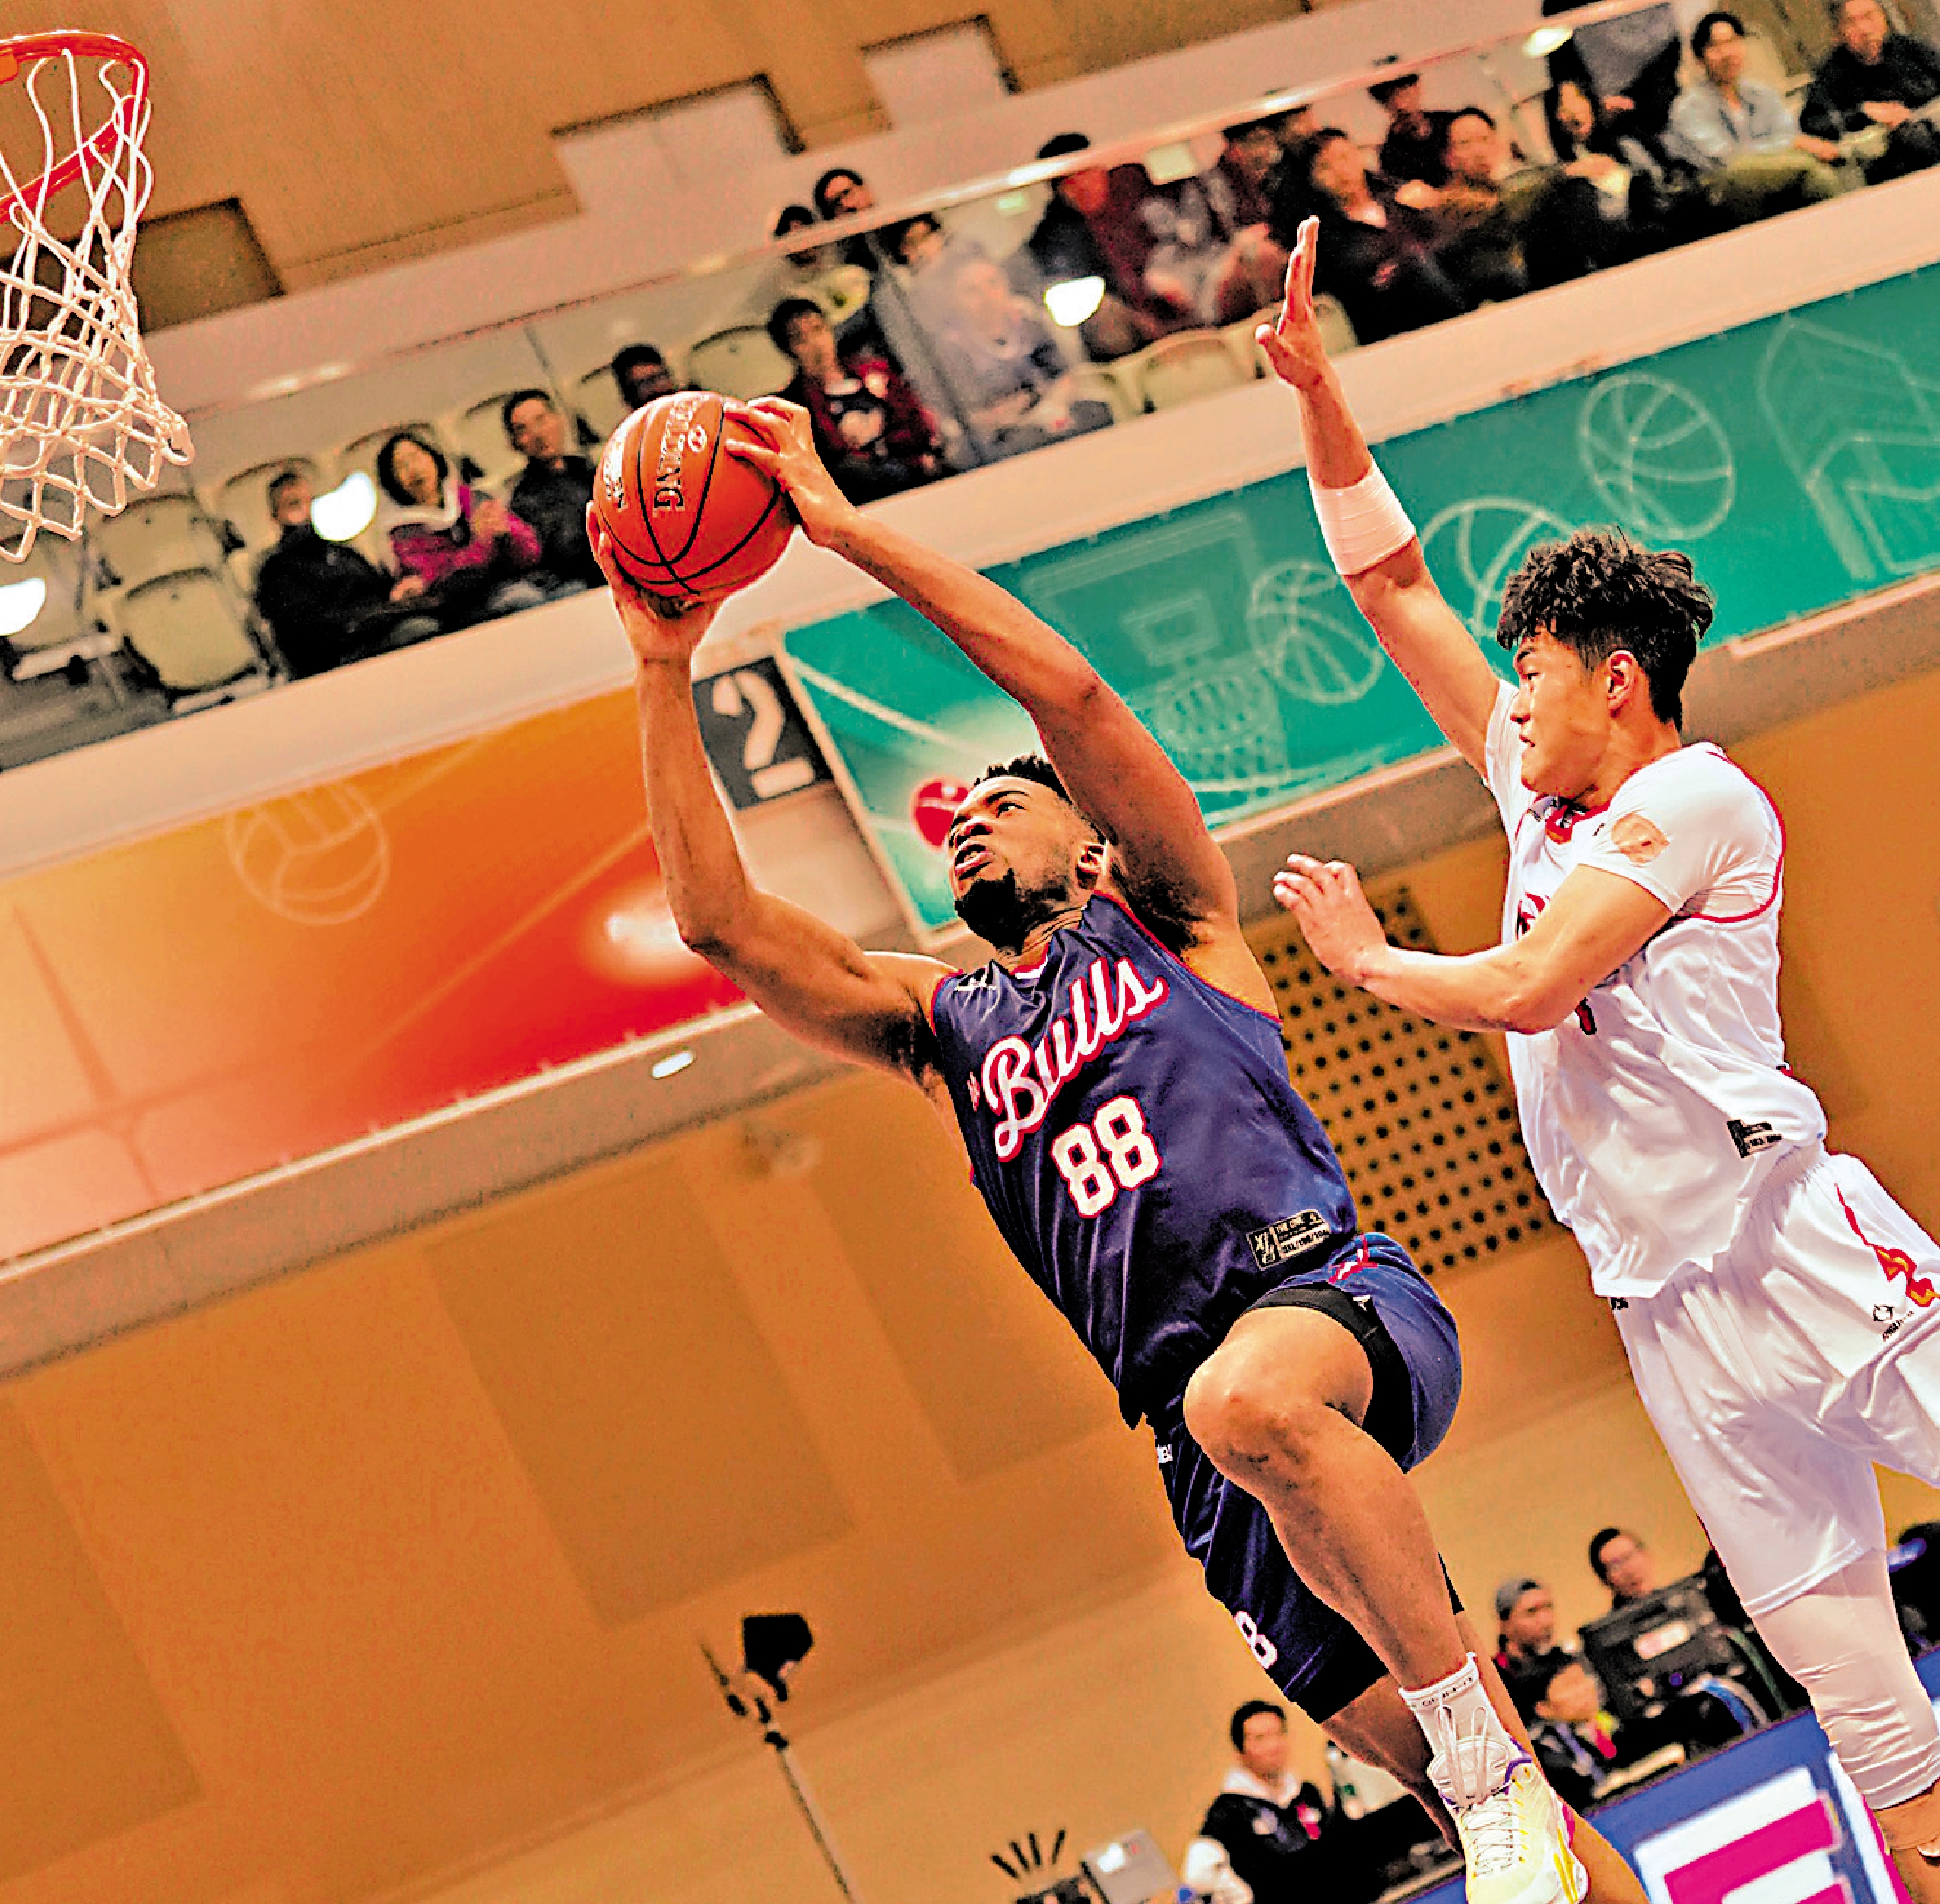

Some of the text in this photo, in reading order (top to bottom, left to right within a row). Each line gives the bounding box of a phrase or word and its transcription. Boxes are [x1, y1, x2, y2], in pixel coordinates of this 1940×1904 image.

[653, 393, 707, 515] LDING
[712, 671, 815, 799] 2
[981, 955, 1170, 1162] Bulls
[1051, 1095, 1163, 1219] 88
[1233, 1611, 1277, 1669] 8
